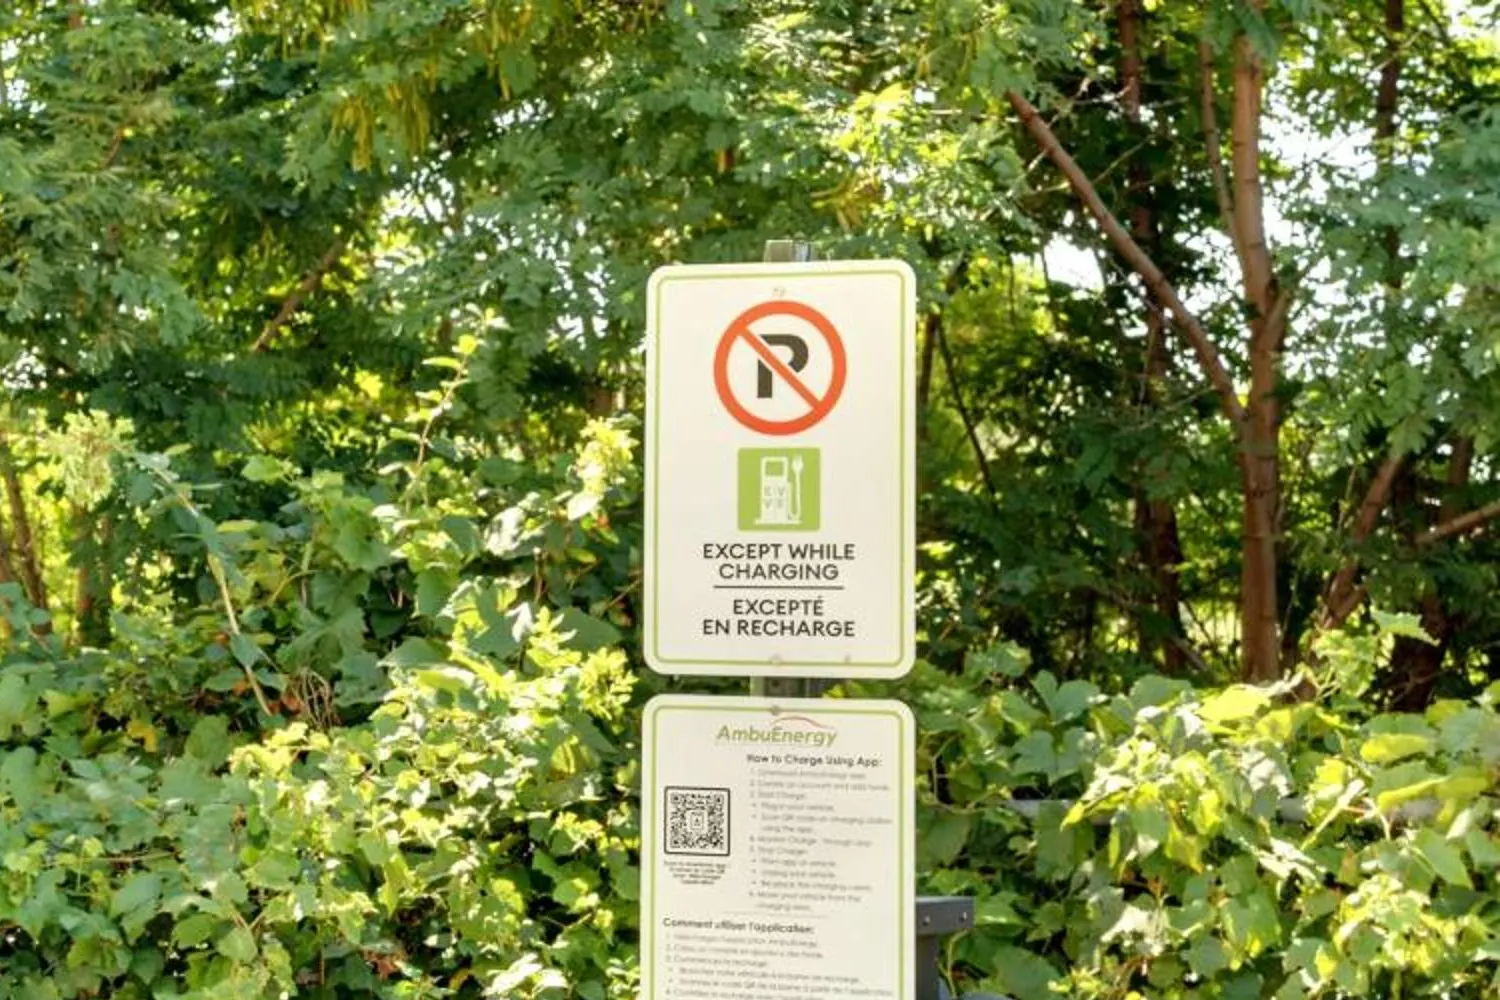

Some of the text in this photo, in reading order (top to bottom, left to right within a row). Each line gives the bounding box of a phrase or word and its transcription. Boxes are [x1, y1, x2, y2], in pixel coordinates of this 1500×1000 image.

[756, 333, 810, 399] P
[702, 543, 855, 560] EXCEPT WHILE
[719, 563, 839, 580] CHARGING
[733, 596, 824, 616] EXCEPTÉ
[702, 620, 855, 637] EN RECHARGE
[716, 725, 837, 747] AmbuEnergy
[746, 754, 884, 768] How to Charge Using App:
[662, 916, 714, 929] Comment
